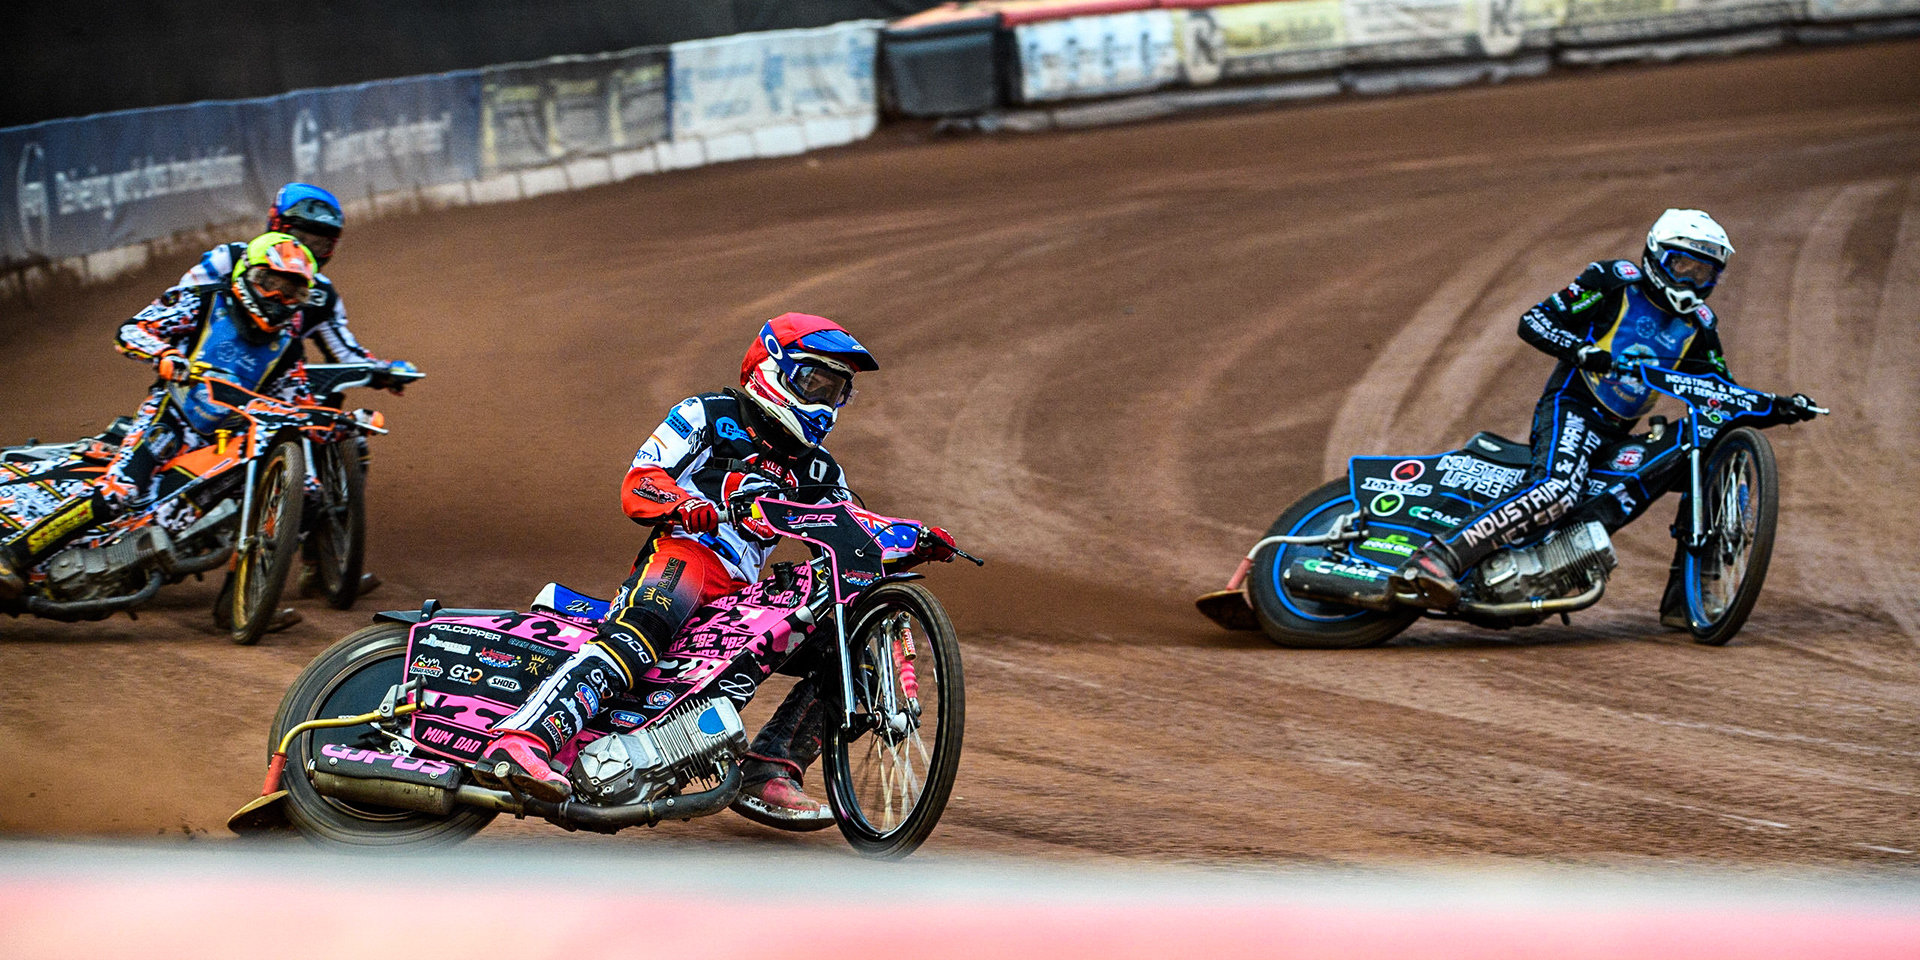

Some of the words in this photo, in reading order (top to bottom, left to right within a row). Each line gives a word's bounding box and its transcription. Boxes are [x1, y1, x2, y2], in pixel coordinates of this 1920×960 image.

[1461, 476, 1570, 548] INDUSTRIAL
[1555, 458, 1575, 475] &
[787, 513, 837, 525] JPR
[430, 624, 502, 641] POLCOPPER
[491, 677, 518, 691] SHOEI
[421, 726, 451, 746] MUM
[452, 736, 482, 753] DAD
